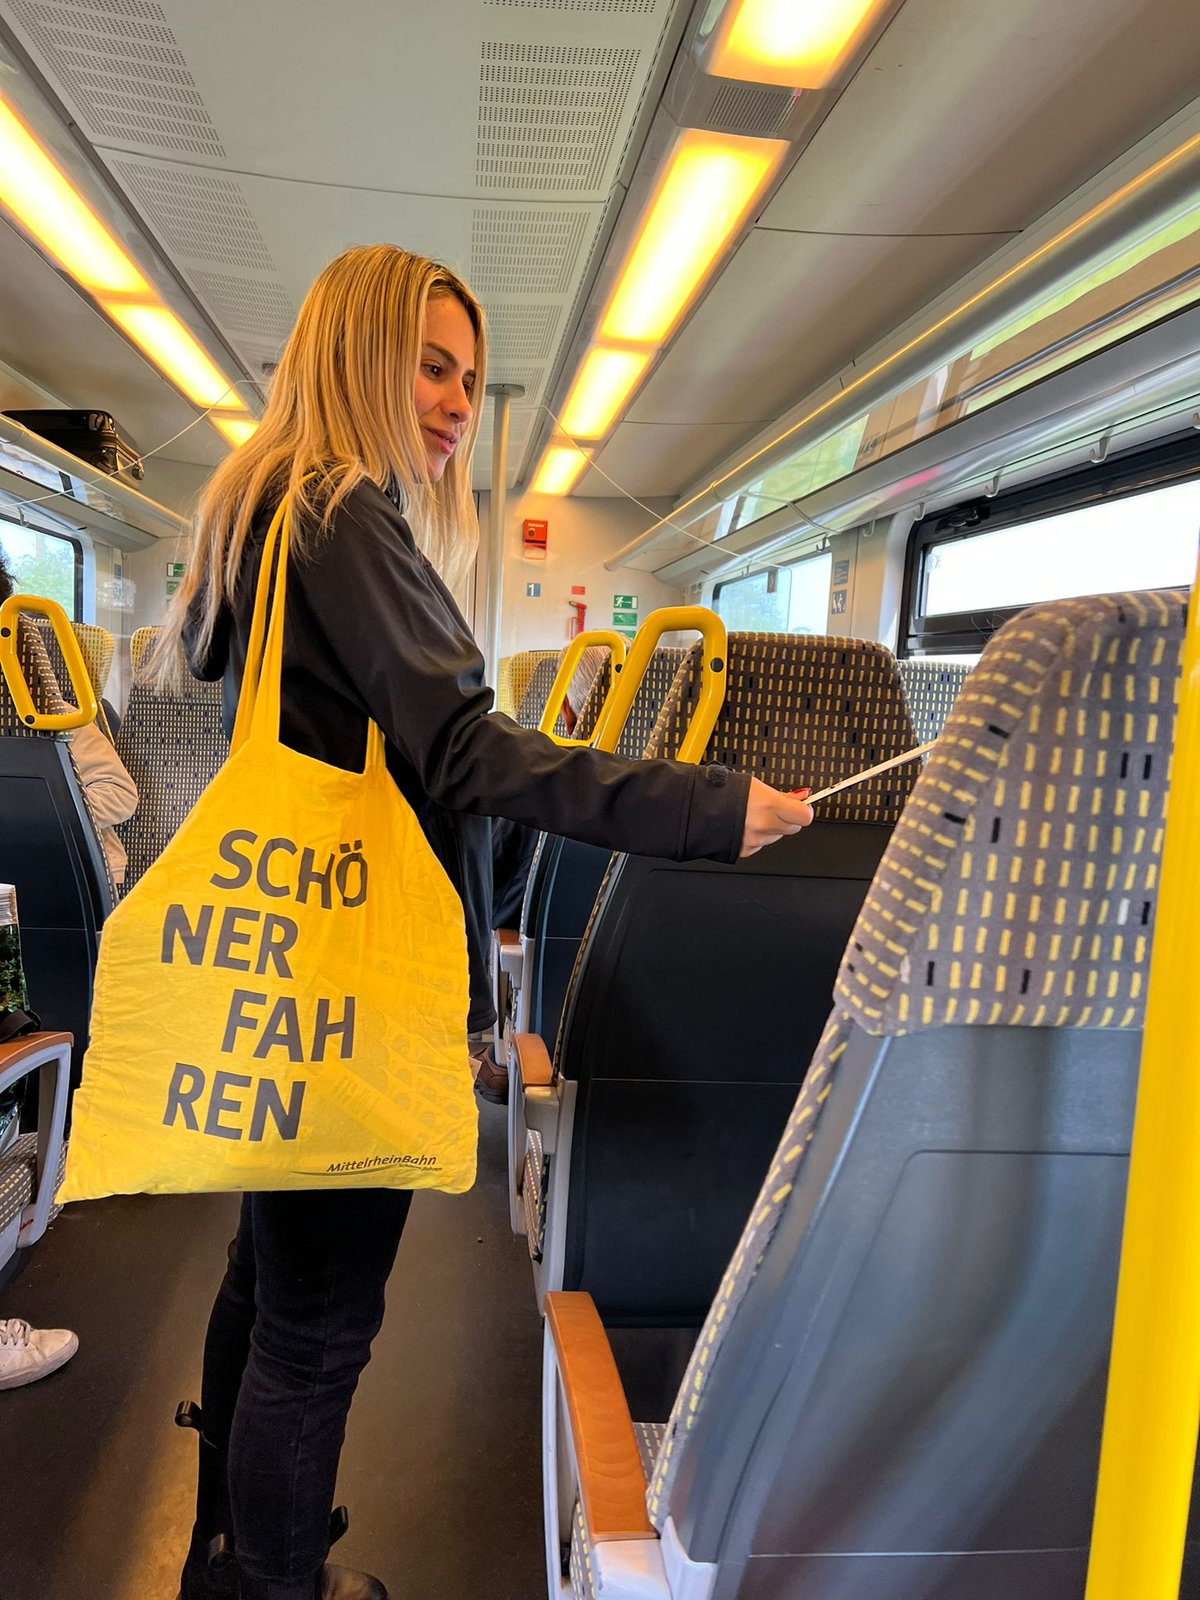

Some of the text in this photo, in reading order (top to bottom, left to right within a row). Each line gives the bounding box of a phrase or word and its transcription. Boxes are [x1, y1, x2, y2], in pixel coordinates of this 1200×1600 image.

[528, 584, 535, 596] 1
[211, 829, 368, 909] SCHÖ
[161, 905, 299, 978] NER
[222, 989, 355, 1063] FAH
[162, 1063, 306, 1141] REN
[327, 1155, 436, 1173] MittelrheinBahn
